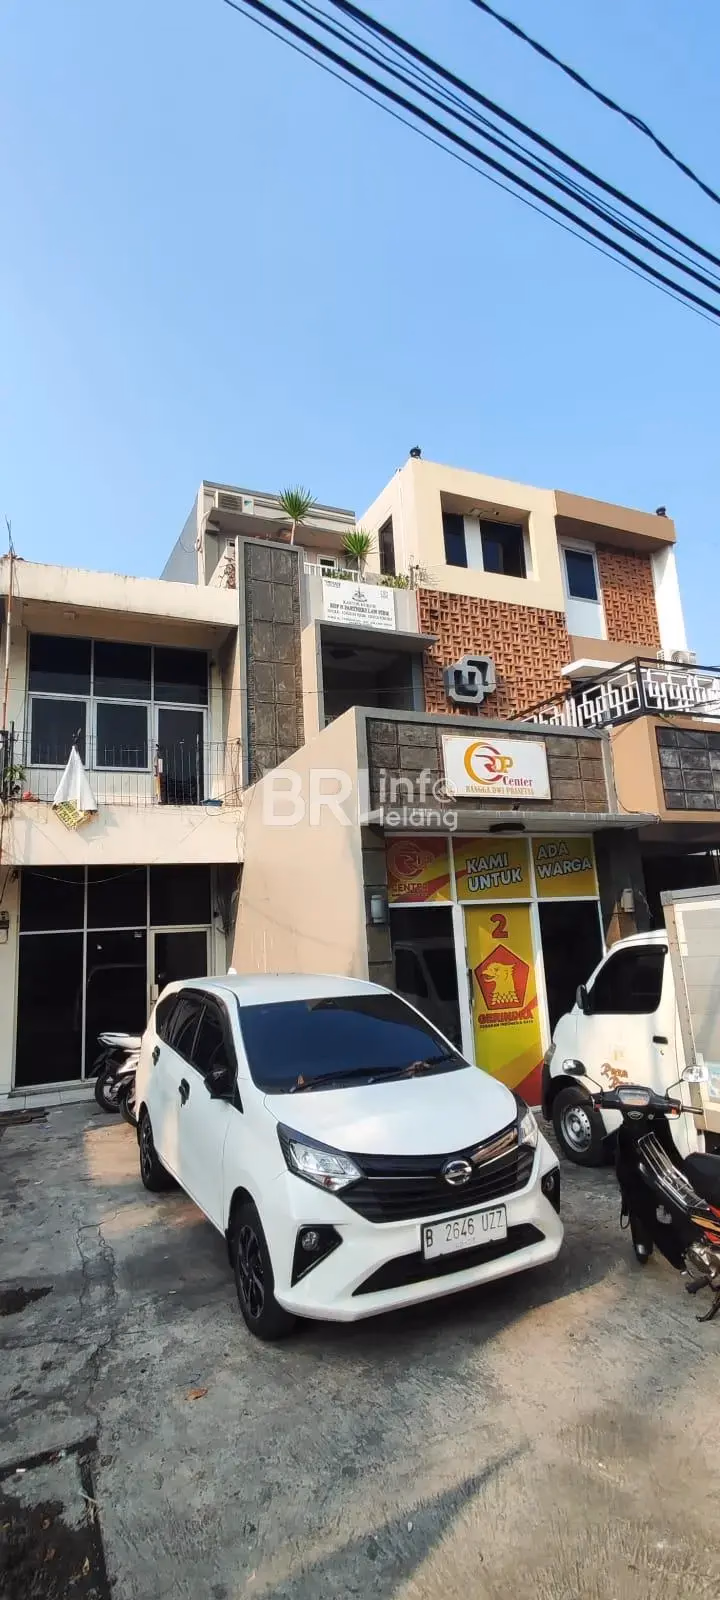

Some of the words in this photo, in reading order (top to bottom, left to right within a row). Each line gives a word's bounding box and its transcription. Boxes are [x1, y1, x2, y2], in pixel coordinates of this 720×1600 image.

[502, 775, 533, 787] Center
[538, 842, 568, 859] ADA
[466, 852, 509, 874] KAMI
[538, 858, 593, 879] WARGA
[468, 868, 522, 892] UNTUK
[490, 913, 508, 938] 2
[478, 1010, 533, 1024] GERINDRA
[426, 1228, 433, 1248] B
[445, 1218, 475, 1242] 2646
[481, 1210, 503, 1231] UZZ
